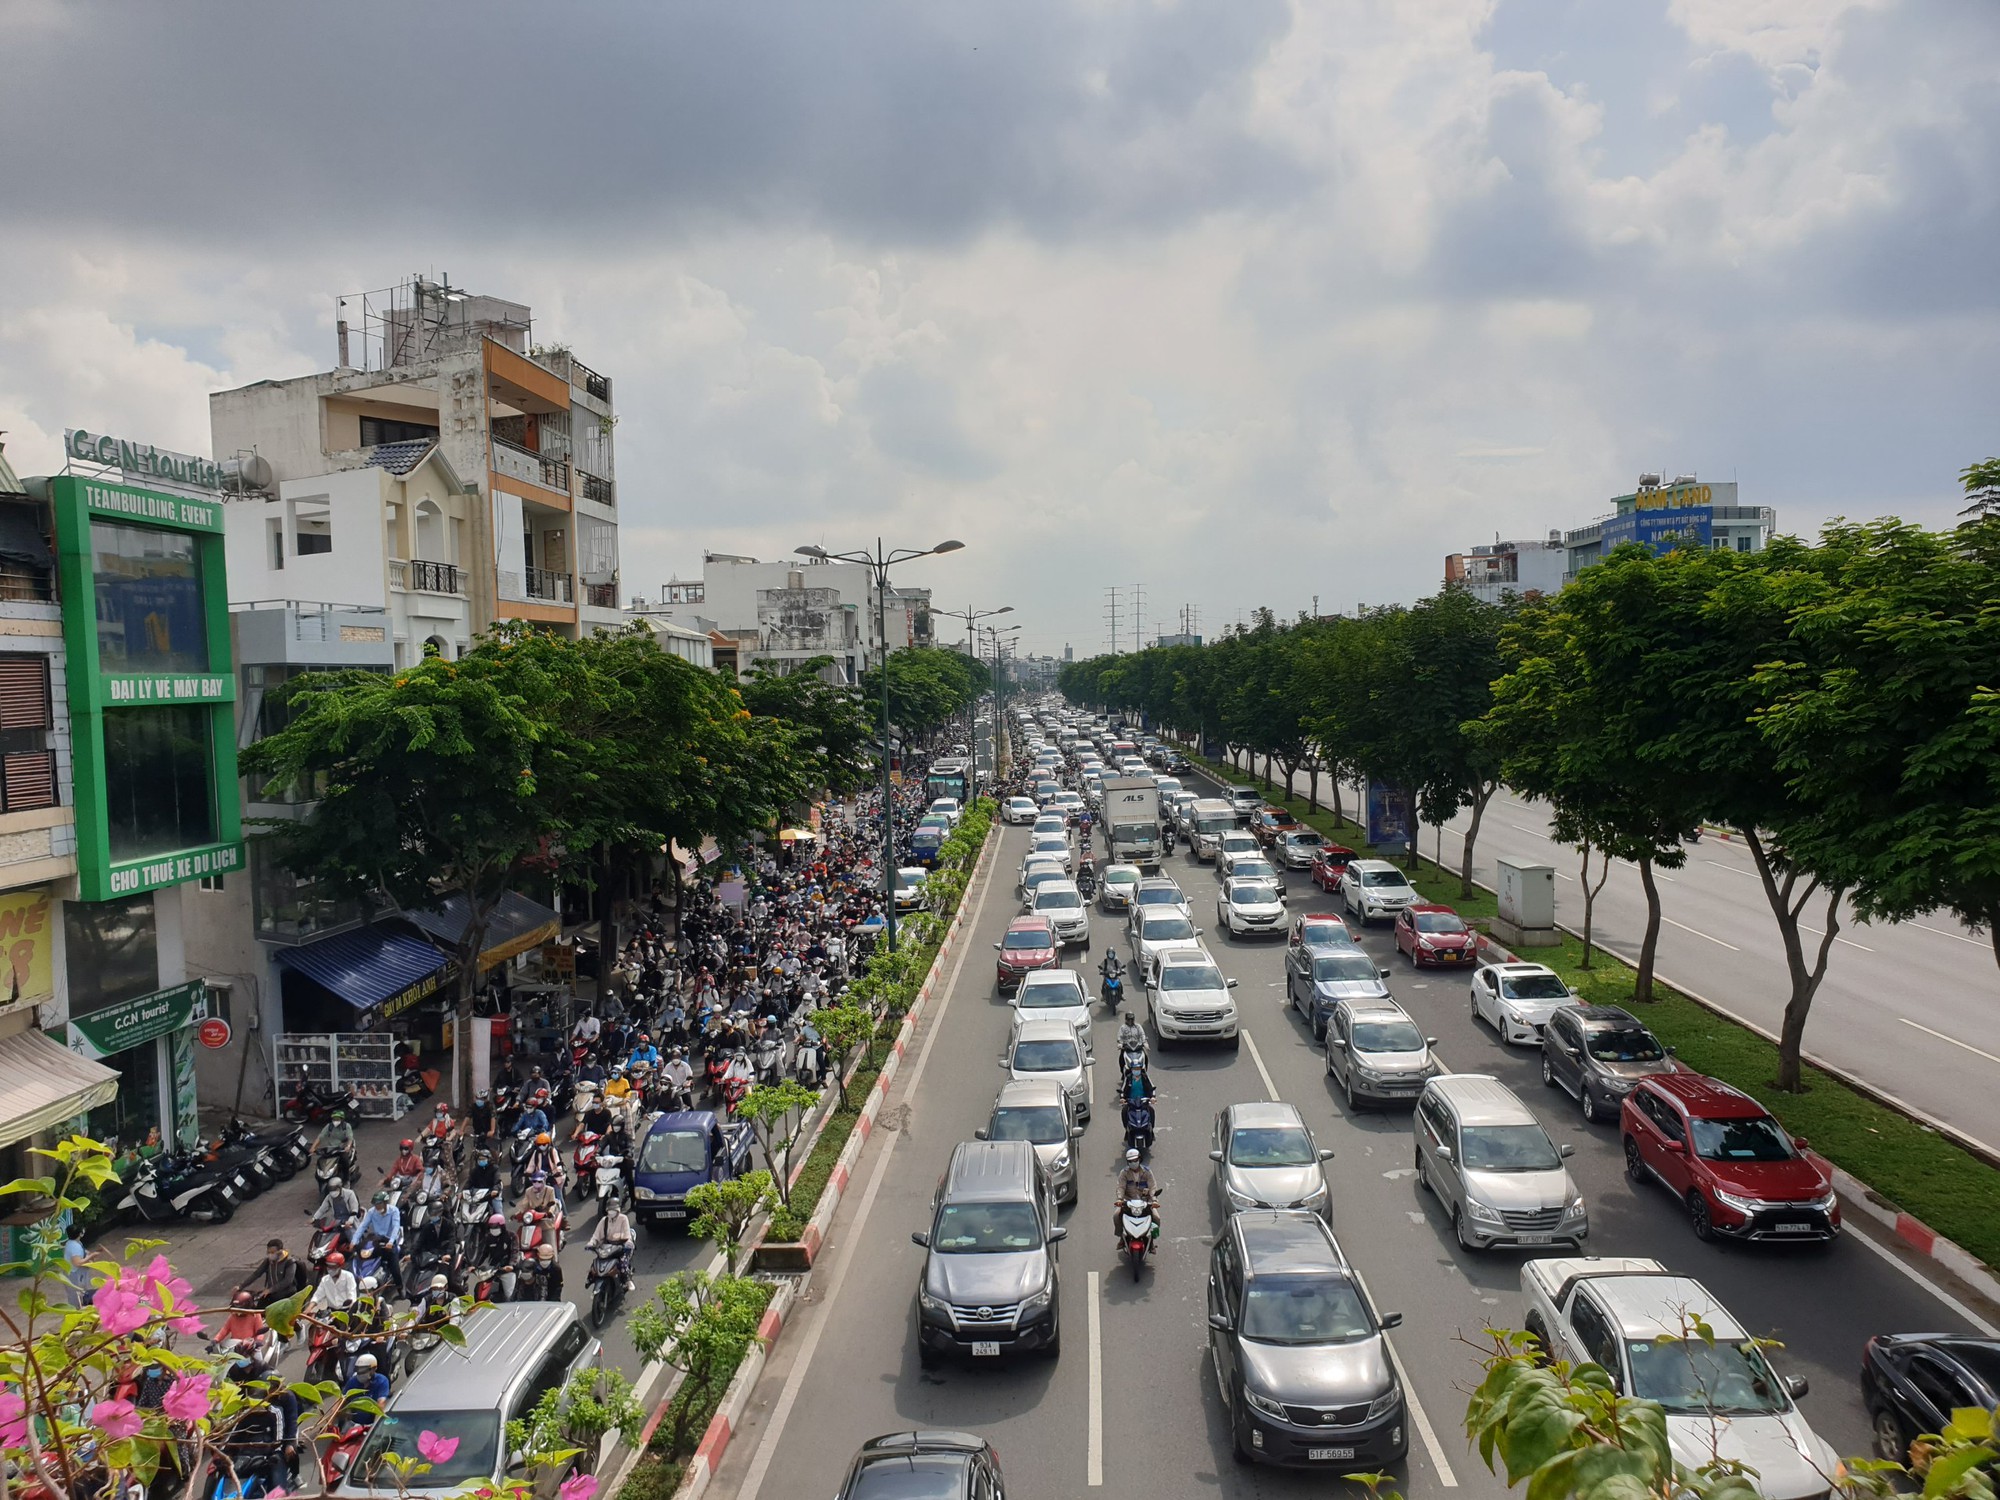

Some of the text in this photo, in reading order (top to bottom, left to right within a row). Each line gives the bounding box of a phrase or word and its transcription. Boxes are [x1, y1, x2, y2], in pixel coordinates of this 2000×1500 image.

[146, 445, 224, 490] tourist
[1672, 485, 1712, 507] LAND
[180, 504, 213, 526] EVENT
[906, 608, 914, 635] HOTEL
[110, 676, 223, 703] ĐẠI LÝ VÉ MÁY BAY
[1122, 794, 1145, 802] ALS
[110, 847, 237, 893] CHO THUÊ XE DU LỊCH
[421, 976, 437, 996] ANH
[114, 1011, 139, 1030] C.C.N
[141, 1001, 170, 1020] tourist
